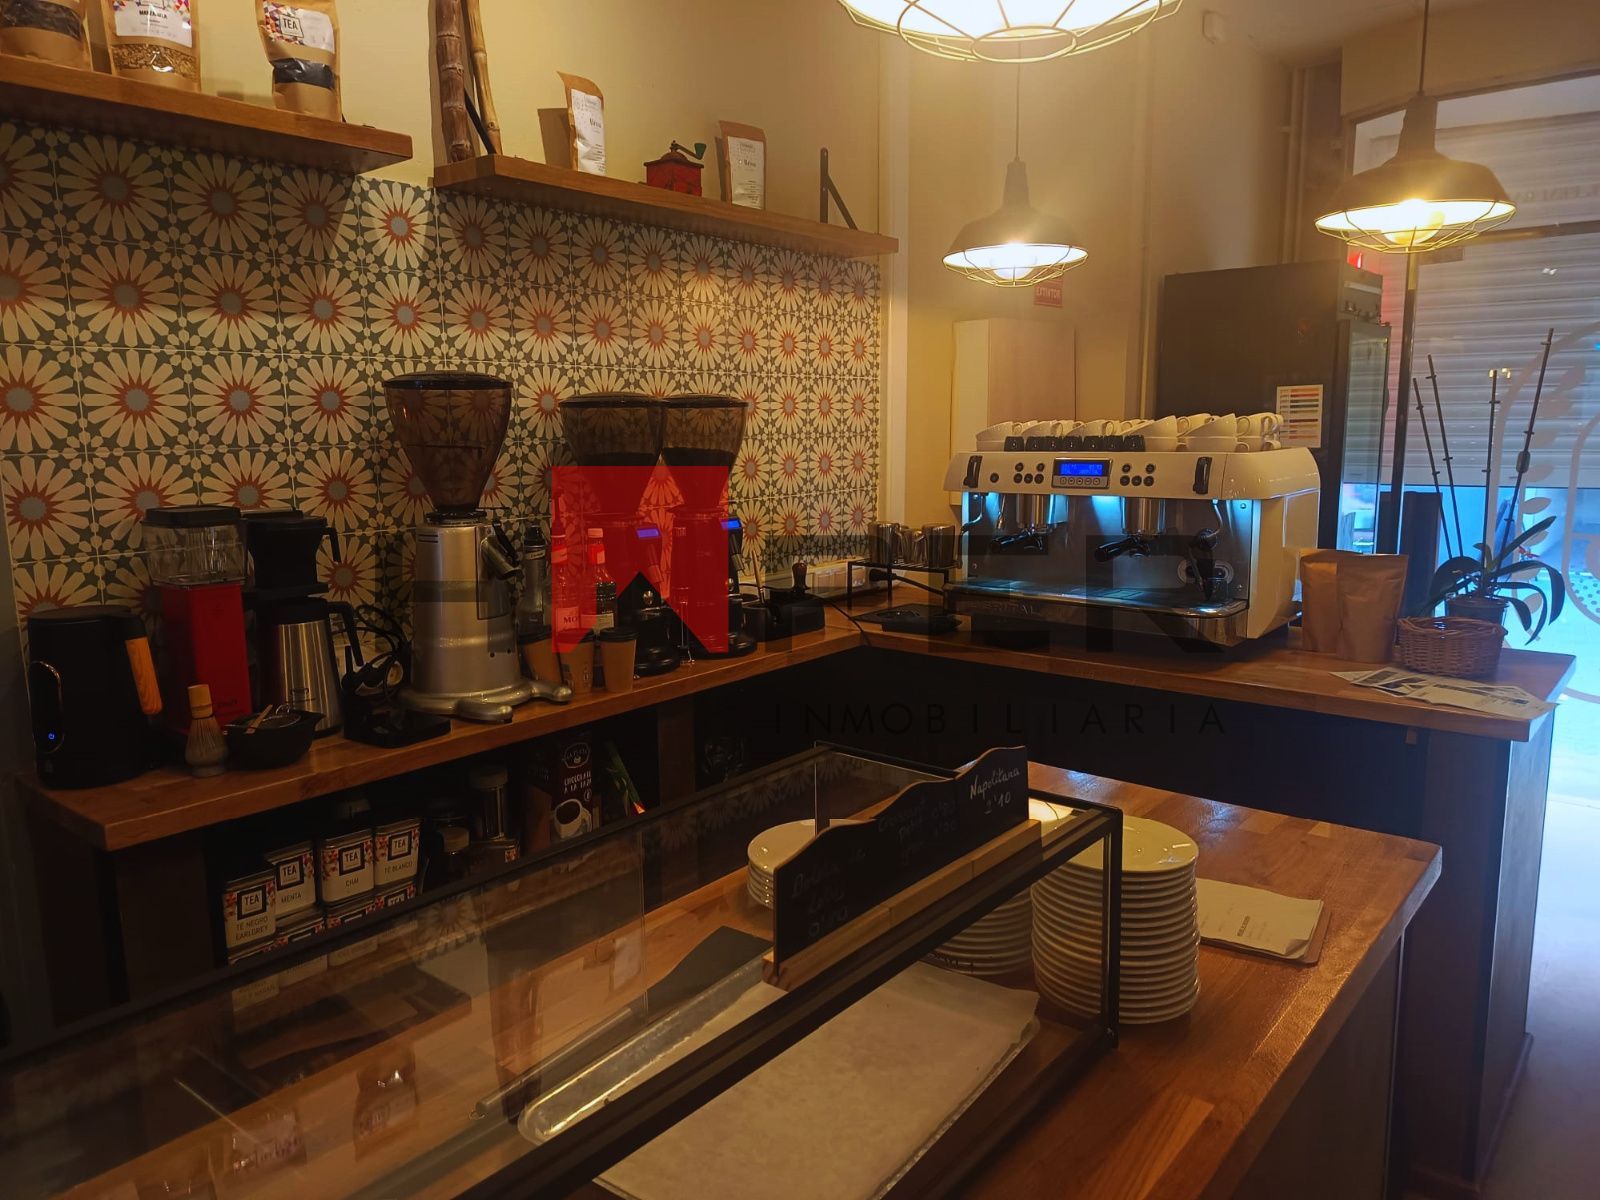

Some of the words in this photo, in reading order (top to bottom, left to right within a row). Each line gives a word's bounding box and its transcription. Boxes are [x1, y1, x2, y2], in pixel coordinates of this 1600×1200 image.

[283, 17, 299, 31] TEA
[970, 766, 1020, 800] Napolitana
[394, 839, 406, 849] TEA
[345, 851, 359, 863] TEA
[282, 864, 297, 877] TEA
[245, 894, 260, 905] TEA
